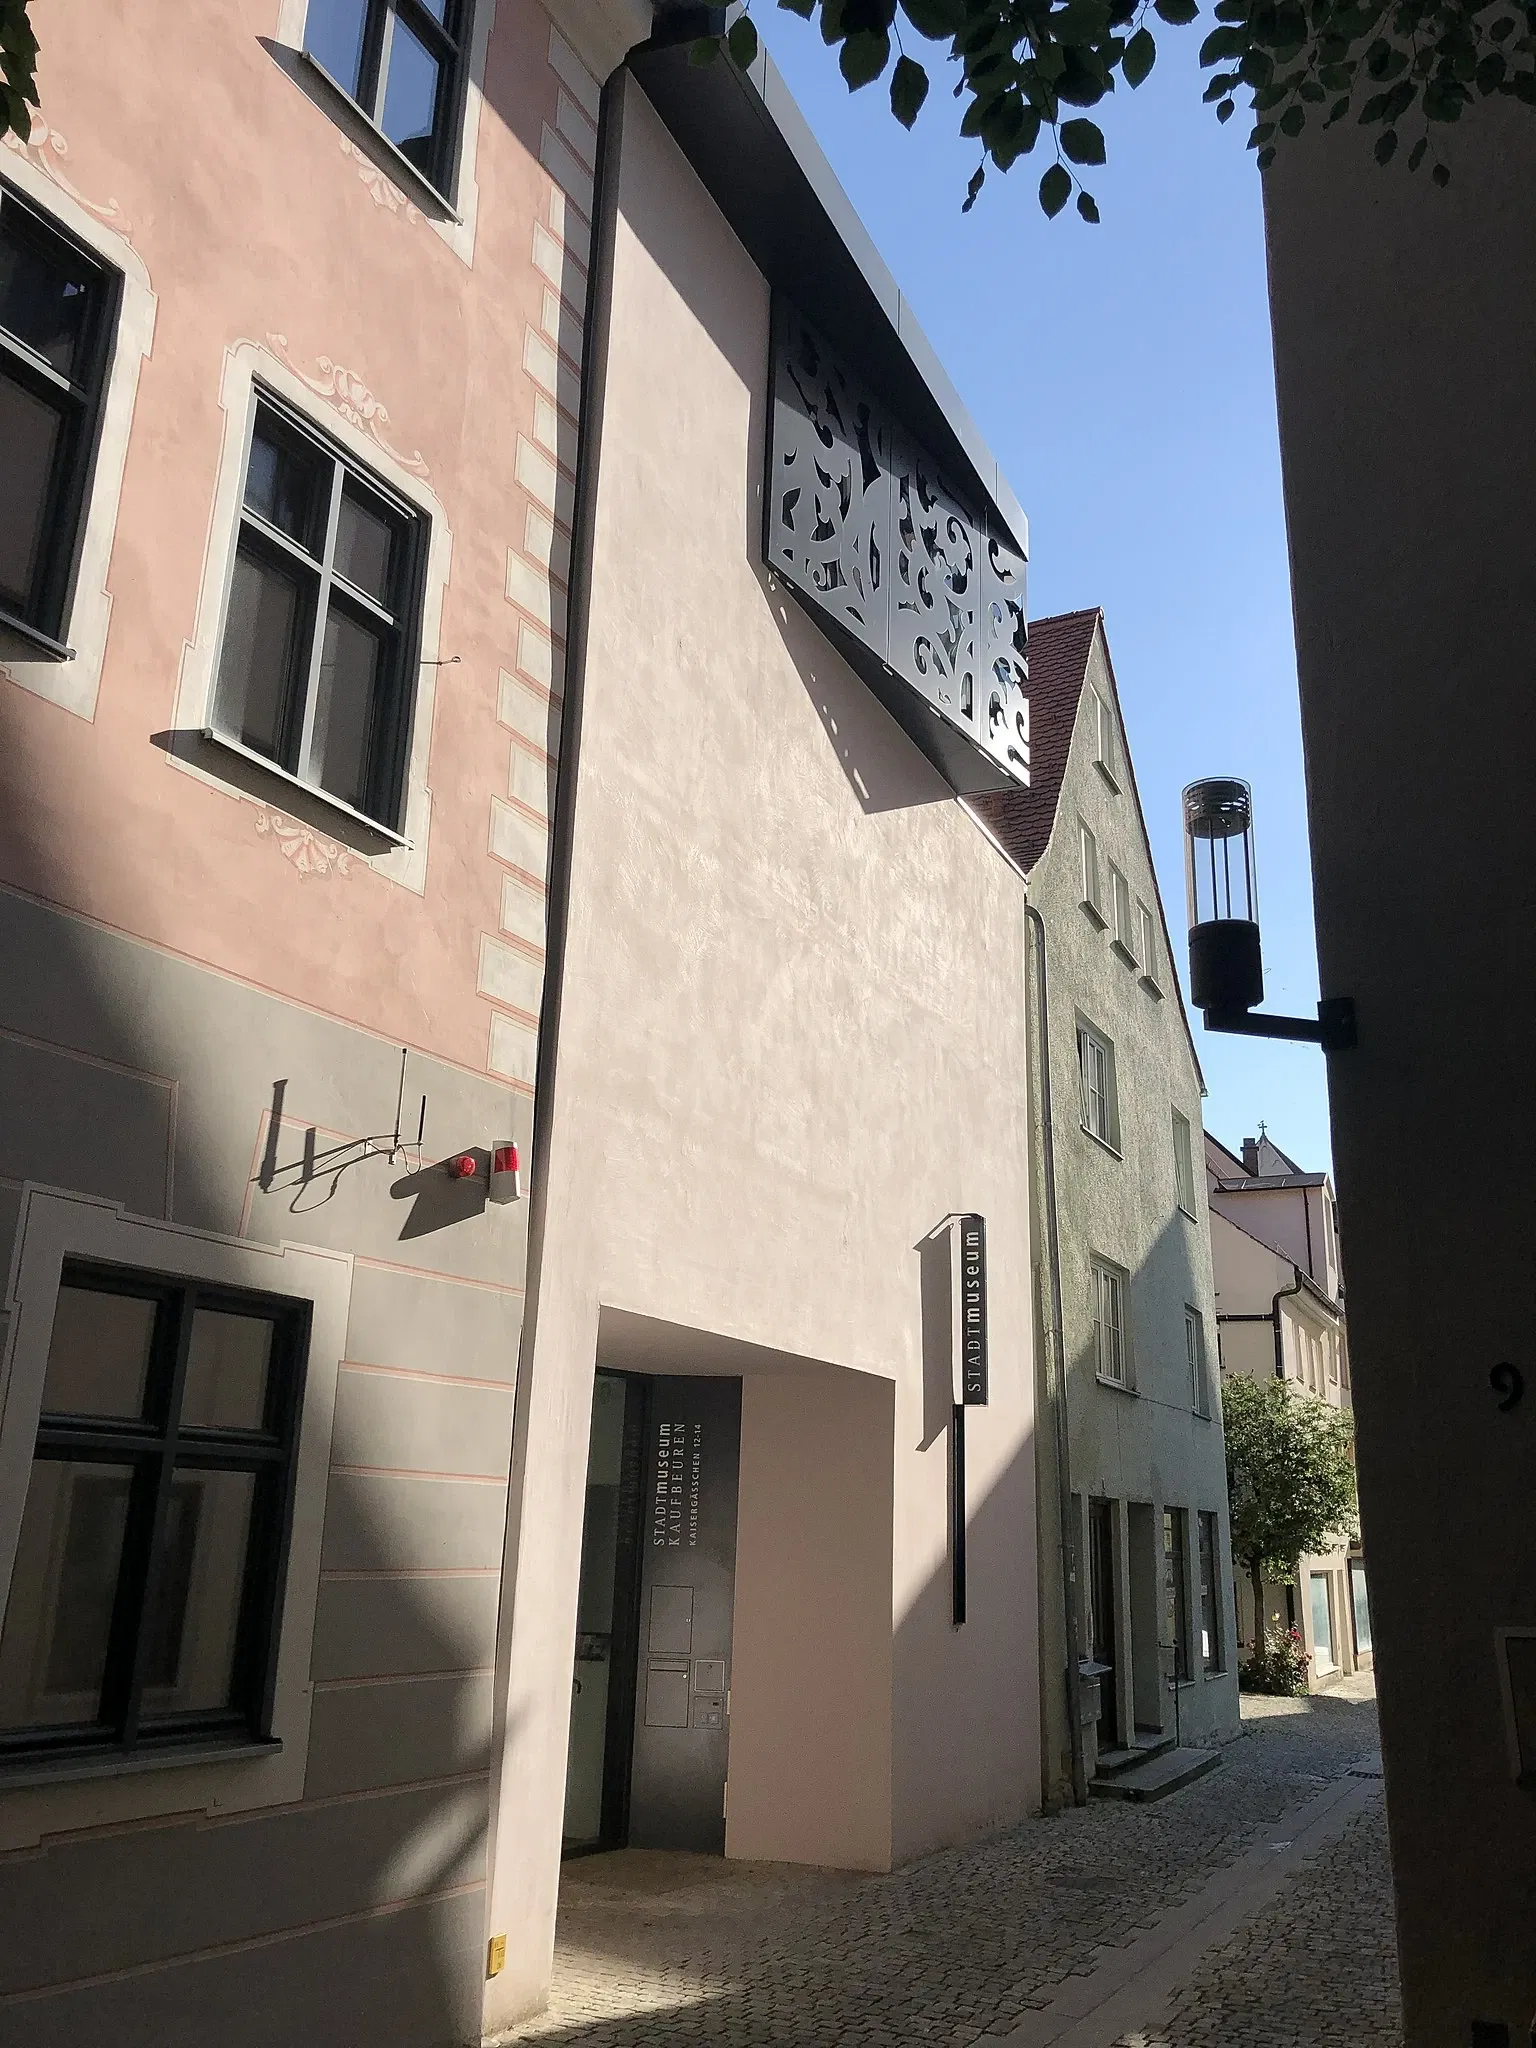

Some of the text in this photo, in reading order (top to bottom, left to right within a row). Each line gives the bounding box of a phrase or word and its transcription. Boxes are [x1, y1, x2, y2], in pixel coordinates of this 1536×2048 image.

[966, 1230, 981, 1392] STADTmuseum
[1489, 1361, 1524, 1412] 9
[653, 1423, 671, 1546] STADTmuseum
[668, 1423, 686, 1546] KAUFBEUREN
[689, 1424, 701, 1546] KAISERGÄSSCHEN 12-14
